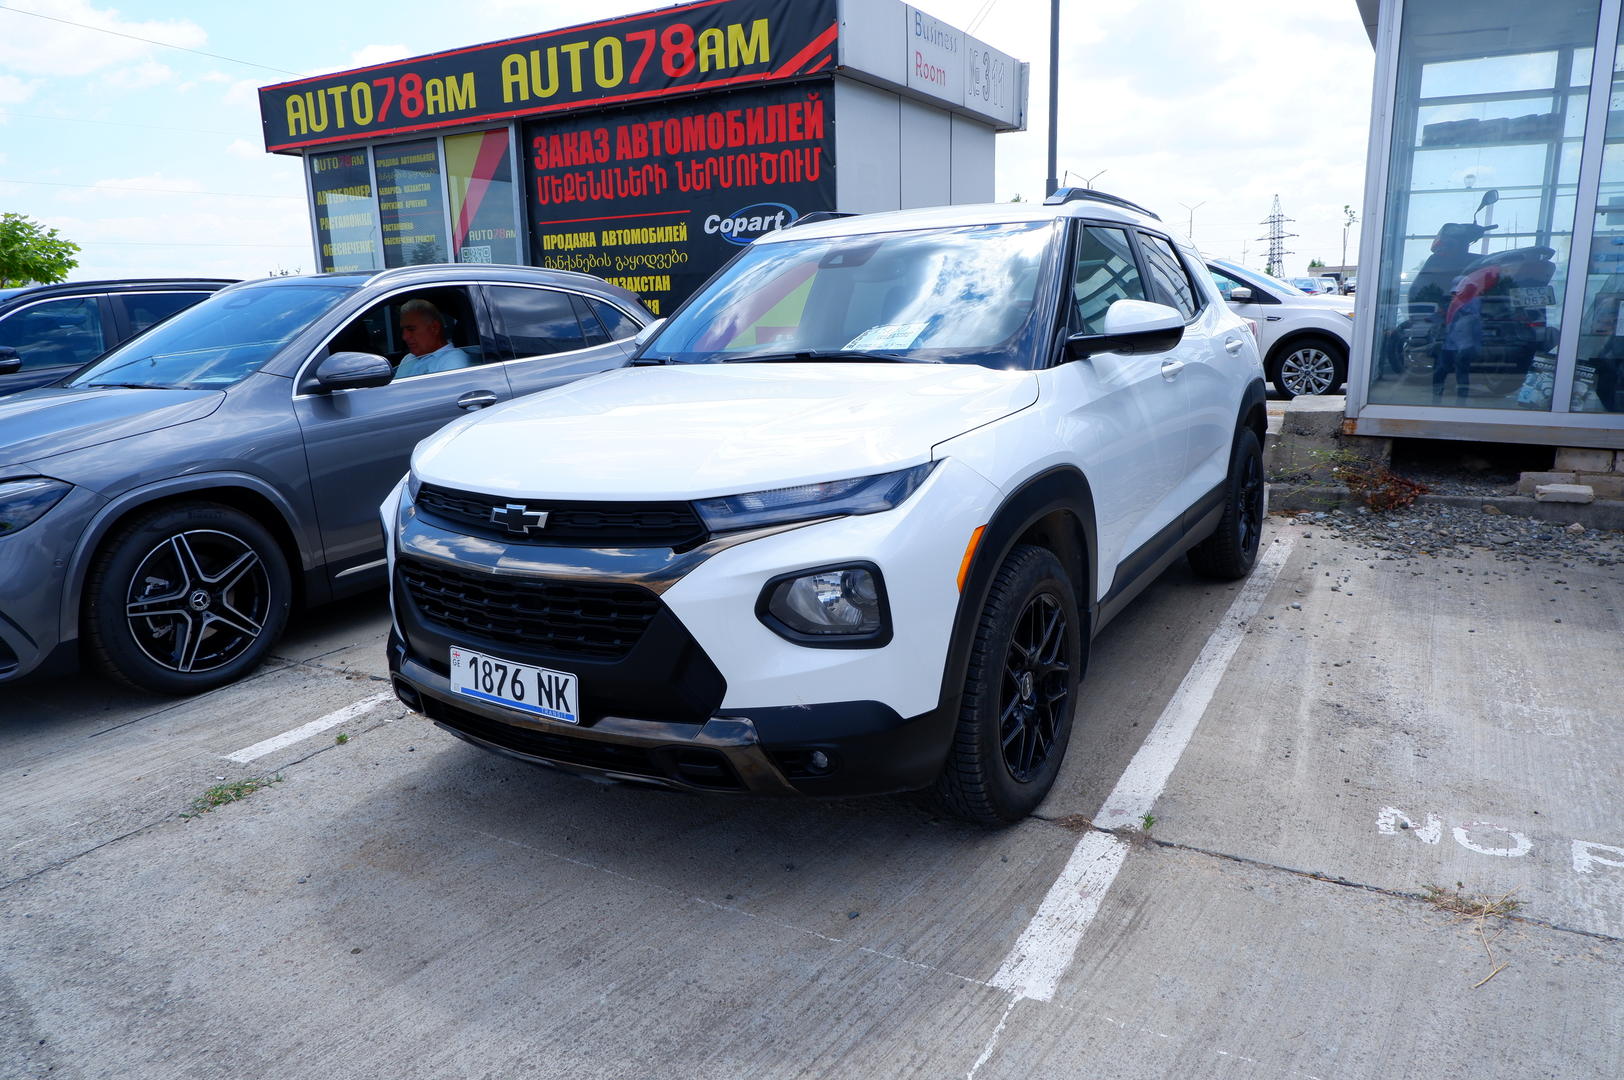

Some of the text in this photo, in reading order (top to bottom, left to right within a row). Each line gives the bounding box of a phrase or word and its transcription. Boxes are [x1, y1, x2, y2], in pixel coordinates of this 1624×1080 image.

[915, 11, 957, 53] Business
[501, 18, 770, 103] AUTO78AM
[915, 51, 946, 87] Room
[286, 72, 477, 137] AUTO78AM
[534, 92, 824, 170] ЗАКАЗ АВТОМОБИЛЕЙ
[543, 222, 688, 251] ПРОДАЖА АВТОМОБИЛЕЙ
[704, 209, 785, 239] Copart
[452, 658, 461, 667] GE
[469, 656, 571, 713] 1876 NK
[1376, 805, 1534, 858] NO
